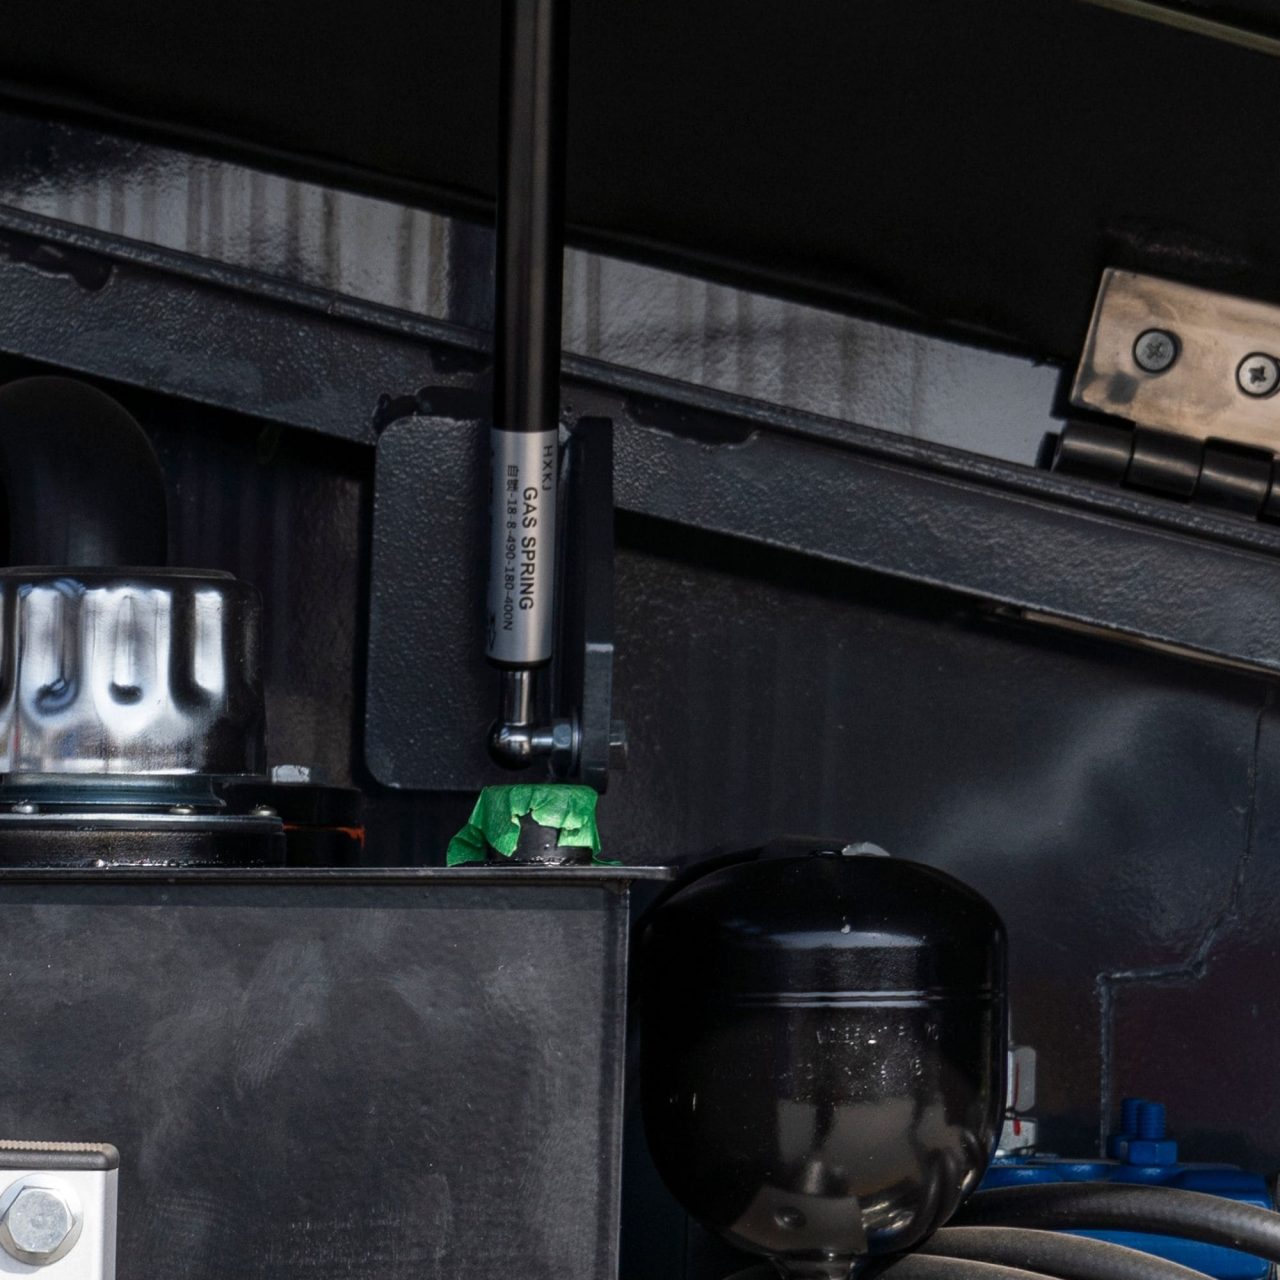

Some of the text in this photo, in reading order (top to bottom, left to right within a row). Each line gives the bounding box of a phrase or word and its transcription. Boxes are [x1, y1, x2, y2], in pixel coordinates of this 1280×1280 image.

[542, 445, 553, 491] HXKJ
[519, 487, 538, 610] GAS SPRING
